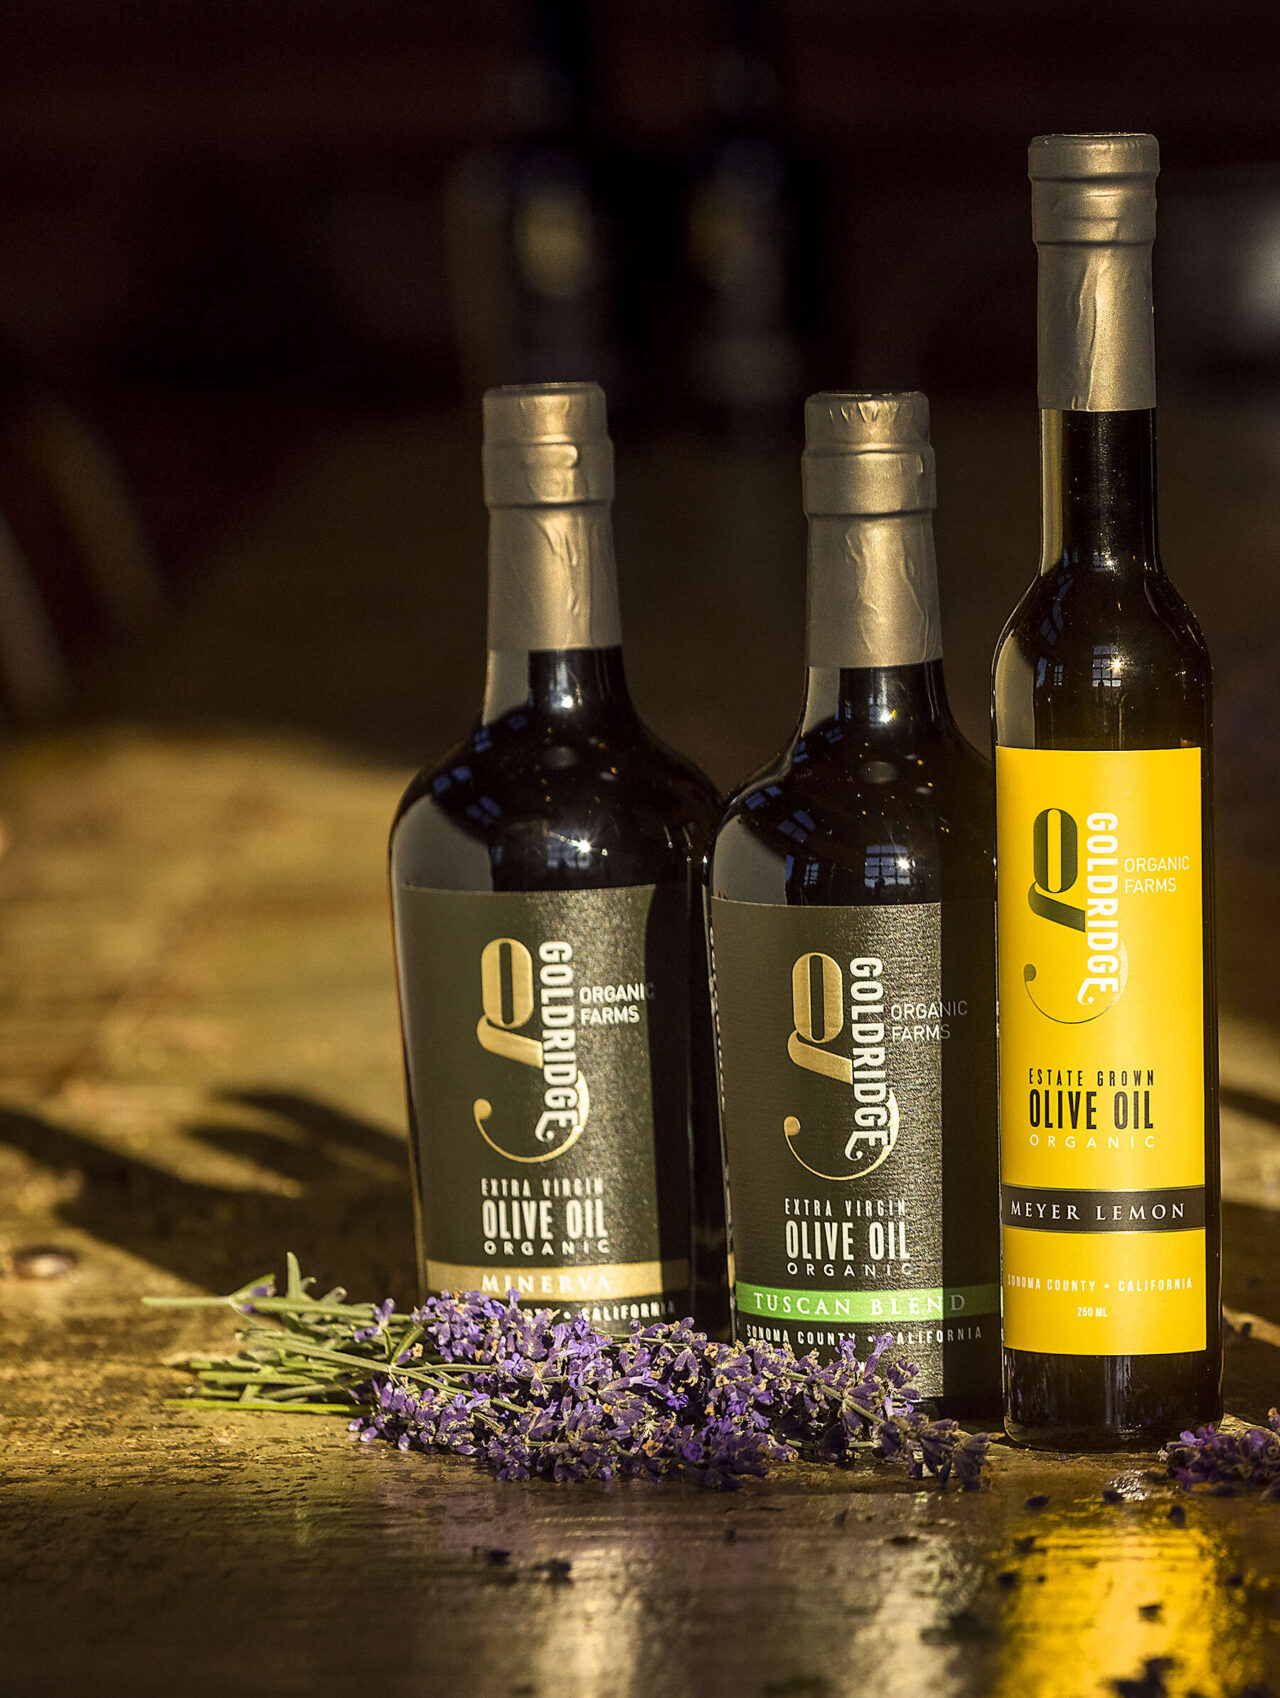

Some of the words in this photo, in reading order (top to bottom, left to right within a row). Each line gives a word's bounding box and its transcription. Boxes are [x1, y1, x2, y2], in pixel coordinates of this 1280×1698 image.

[1124, 856, 1190, 873] ORGANIC
[1124, 876, 1177, 894] FARMS
[1077, 812, 1119, 1006] GOLDRIDGE
[580, 981, 655, 1004] ORGANIC
[580, 1005, 640, 1025] FARMS
[890, 1000, 968, 1022] ORGANIC
[535, 941, 580, 1143] GOLDRIDGE
[891, 1023, 950, 1043] FARMS
[845, 956, 890, 1161] GOLDRIDGE
[1029, 1068, 1084, 1087] ESTATE
[1097, 1068, 1155, 1087] GROWN
[1029, 1090, 1097, 1131] OLIVE
[1114, 1090, 1154, 1130] OIL
[1029, 1133, 1156, 1150] ORGANIC
[481, 1178, 531, 1198] EXTRA
[542, 1178, 604, 1198] VIRGIN
[784, 1197, 833, 1217] EXTRA
[845, 1199, 907, 1217] VIRGIN
[1010, 1200, 1081, 1222] MEYER
[1096, 1201, 1186, 1222] LEMON
[482, 1200, 553, 1240] OLIVE
[566, 1200, 609, 1239] OIL
[483, 1240, 610, 1256] ORGANIC
[785, 1220, 854, 1261] OLIVE
[869, 1220, 912, 1261] OIL
[787, 1262, 913, 1277] ORGANIC
[481, 1274, 611, 1293] MINERVA
[1007, 1274, 1041, 1291] SONOMA
[1046, 1277, 1097, 1292] COUNTY
[1118, 1276, 1193, 1292] CALIFORNIA
[580, 1300, 675, 1322] CALIFORNIA
[753, 1292, 851, 1315] TUSCAN
[871, 1294, 966, 1316] BLEND
[1077, 1306, 1094, 1318] 250
[1095, 1306, 1108, 1318] ML
[746, 1323, 789, 1343] SONOMA
